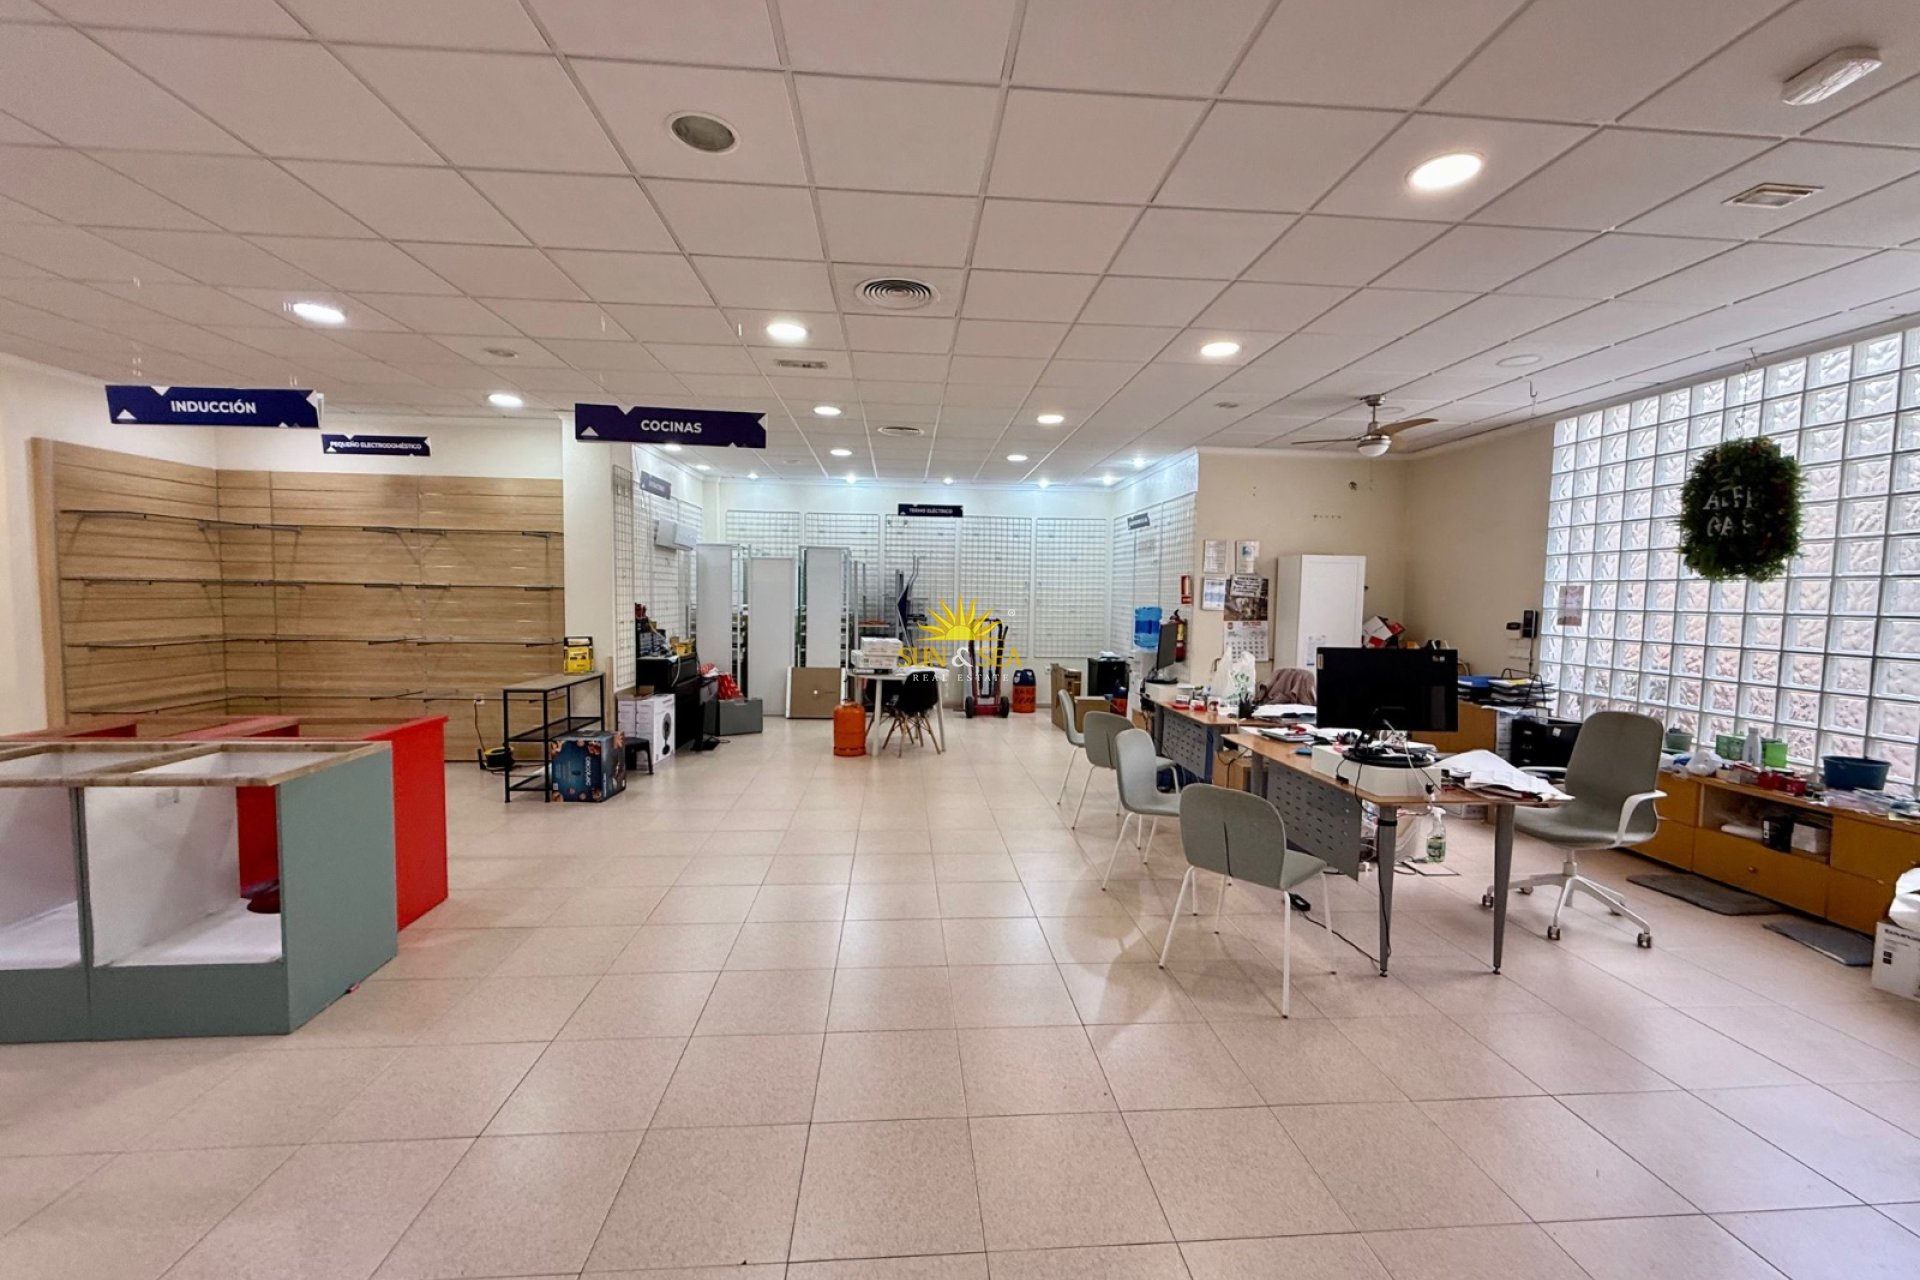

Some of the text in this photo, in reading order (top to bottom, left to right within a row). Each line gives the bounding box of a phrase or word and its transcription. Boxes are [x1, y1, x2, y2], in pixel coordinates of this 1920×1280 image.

[170, 398, 257, 414] INDUCCIÓN
[640, 419, 703, 434] COCINAS
[329, 440, 360, 449] PEQUEÑO
